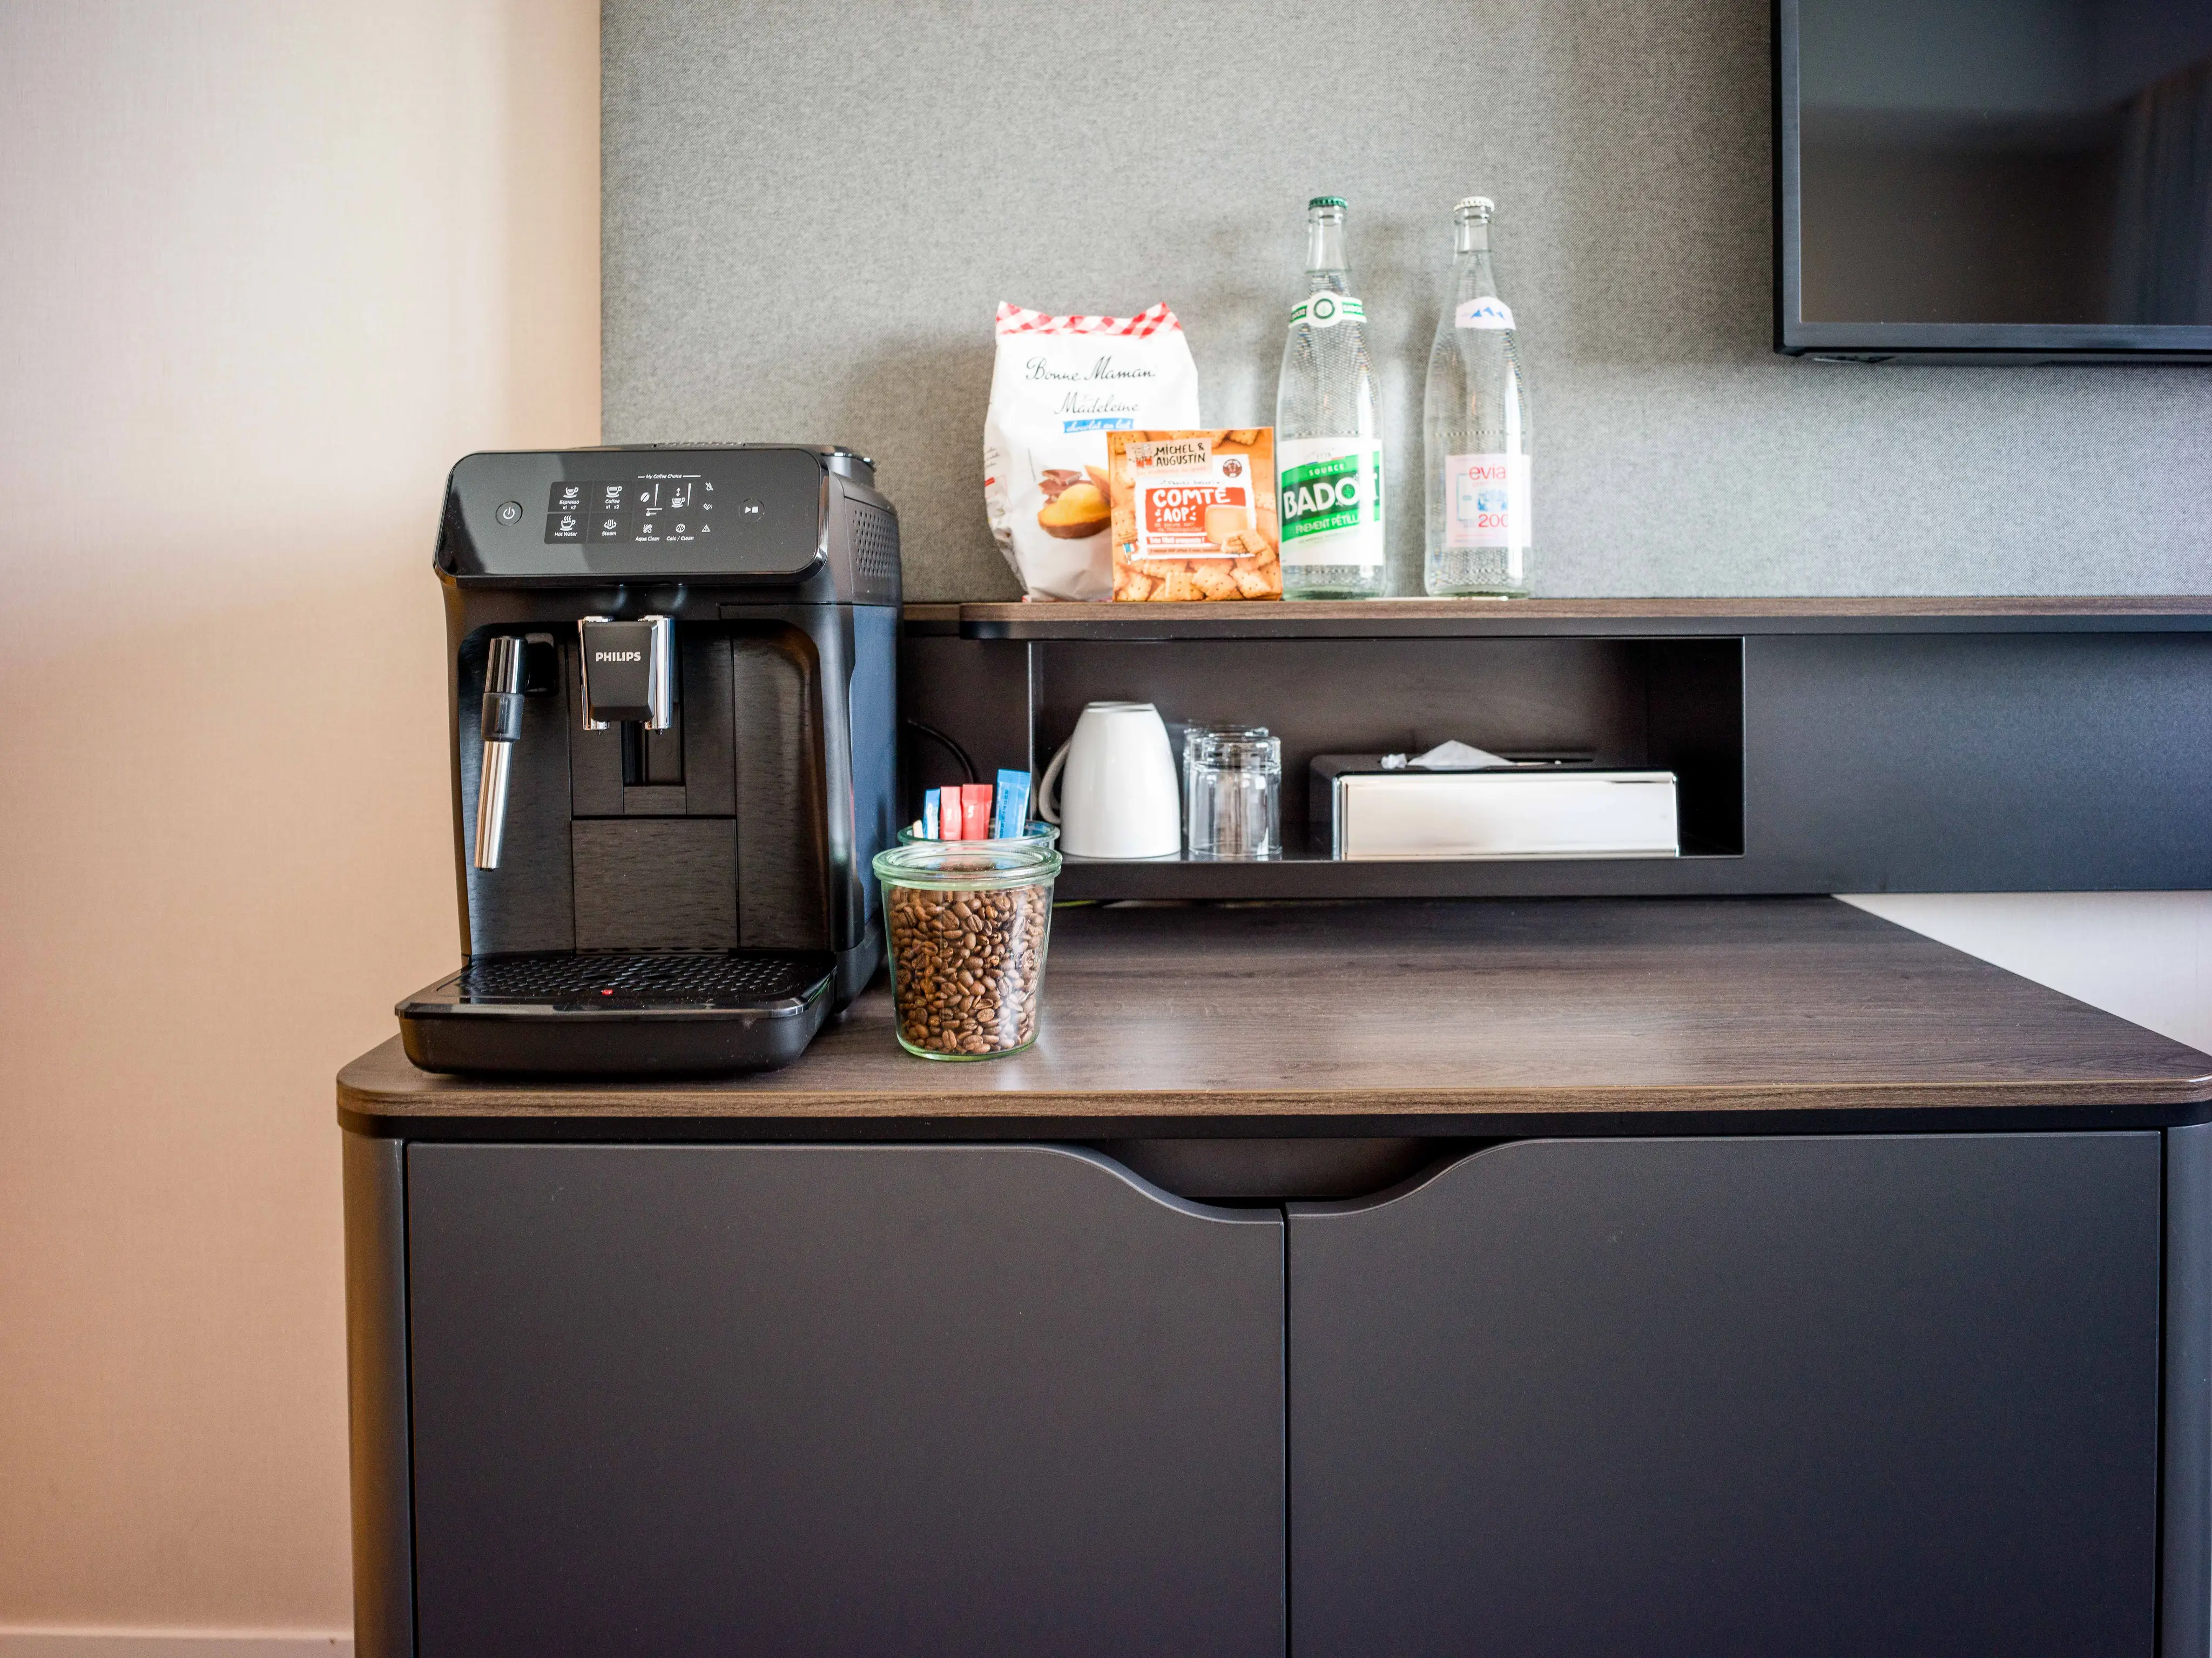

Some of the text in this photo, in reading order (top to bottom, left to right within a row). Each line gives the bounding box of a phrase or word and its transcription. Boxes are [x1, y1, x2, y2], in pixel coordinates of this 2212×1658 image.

[1026, 355, 1156, 381] Bonne Maman
[1054, 392, 1139, 414] Madeleine
[1309, 463, 1345, 476] SOURCE
[1469, 464, 1506, 480] evia
[1283, 472, 1378, 520] BADO
[1163, 507, 1190, 523] AOP
[1331, 514, 1360, 527] PÉTILL
[1478, 514, 1509, 528] 200
[596, 651, 641, 662] PHILIPS
